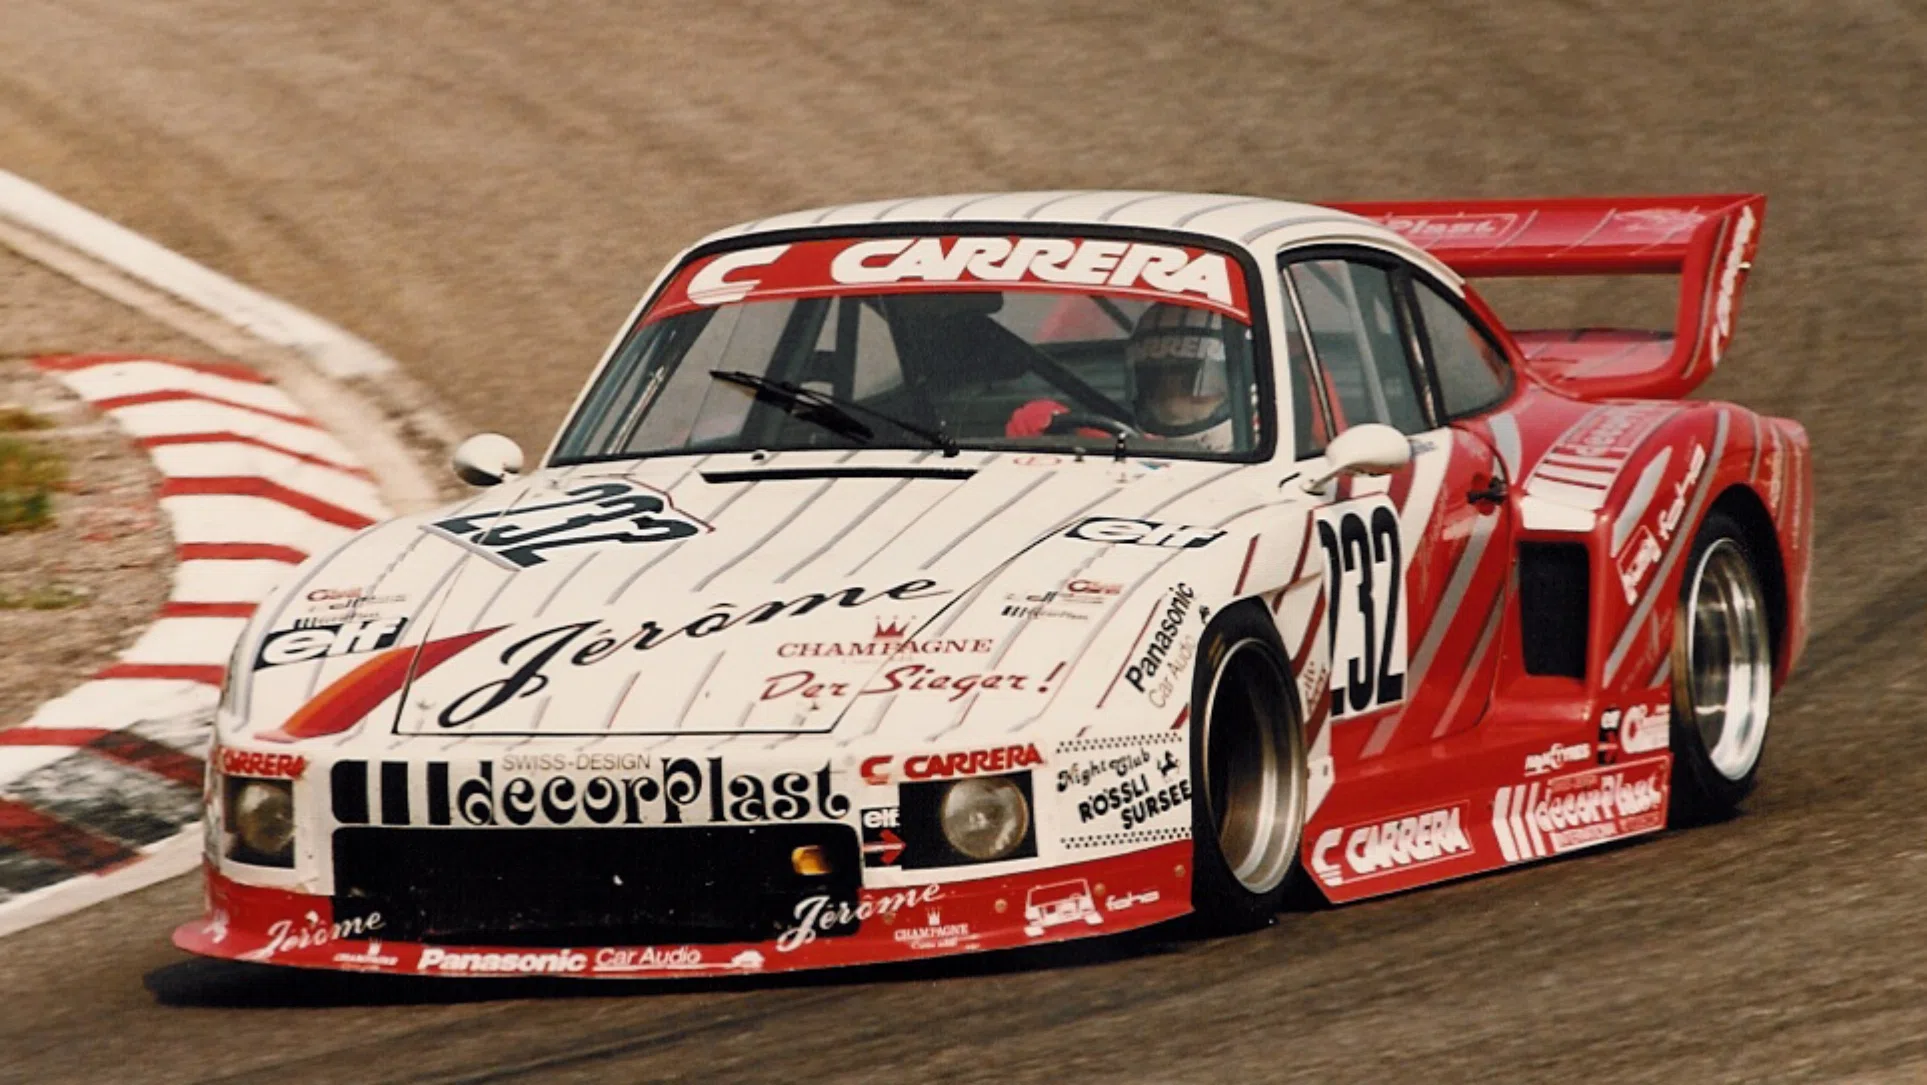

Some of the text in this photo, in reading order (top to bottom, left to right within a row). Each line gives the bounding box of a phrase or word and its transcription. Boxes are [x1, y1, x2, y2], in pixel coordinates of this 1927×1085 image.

[686, 237, 1234, 306] C CARRERA
[432, 483, 698, 567] 232
[1074, 518, 1226, 548] elf
[1317, 506, 1402, 716] 232
[256, 617, 408, 668] elf
[438, 578, 946, 729] Jérôme
[777, 638, 994, 657] CHAMPAGNE
[1125, 582, 1195, 693] Panasonic
[760, 670, 850, 700] Der
[1149, 677, 1174, 708] Car
[502, 753, 650, 773] SWISS-DESIGN
[904, 743, 1043, 780] CARRERA
[1057, 760, 1106, 792] Night
[863, 810, 900, 829] elf
[1121, 779, 1191, 829] SURSEE
[1345, 807, 1470, 874] CARRERA
[776, 883, 942, 952] Jérôme
[417, 949, 587, 972] Panasonic
[595, 949, 634, 967] Car
[639, 947, 701, 966] Audio
